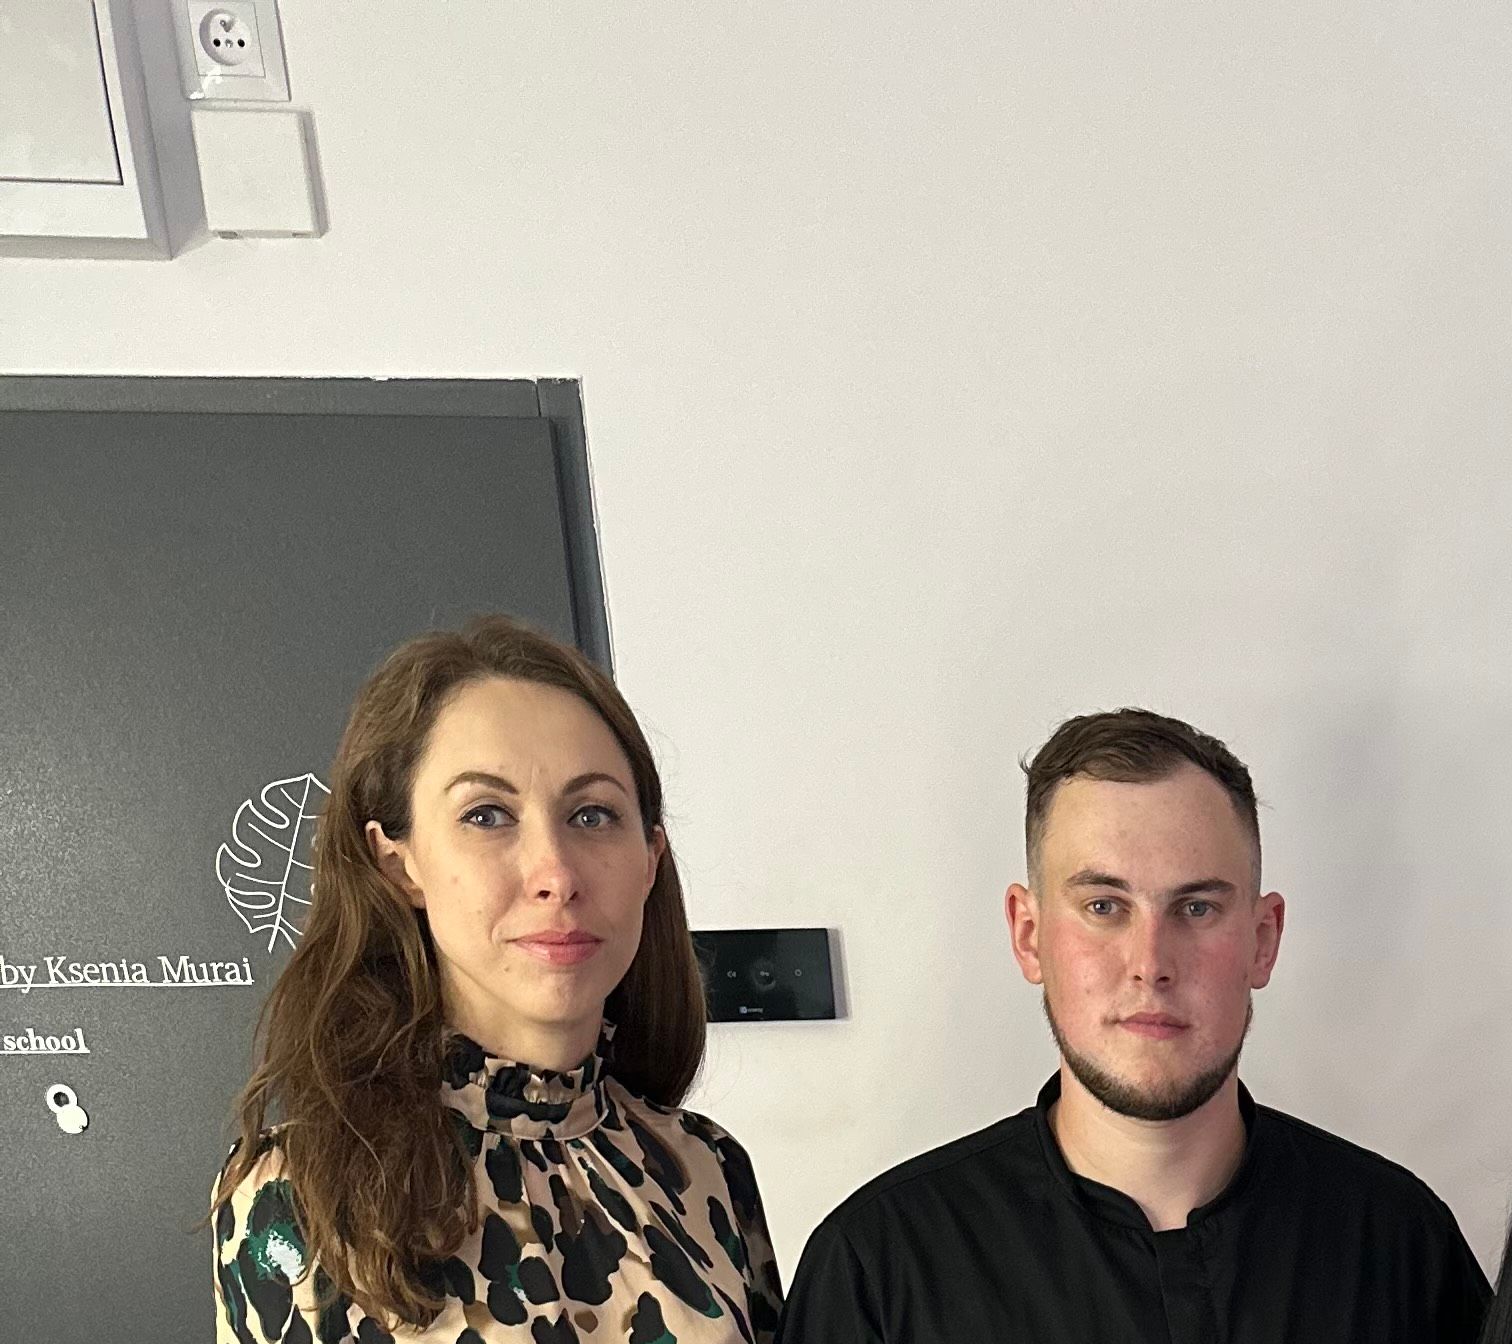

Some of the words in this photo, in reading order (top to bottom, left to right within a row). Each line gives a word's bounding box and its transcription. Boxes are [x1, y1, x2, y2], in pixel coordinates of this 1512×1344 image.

[0, 955, 36, 993] by
[44, 955, 150, 984] Ksenia
[158, 955, 254, 985] Murai
[3, 1027, 87, 1051] school
